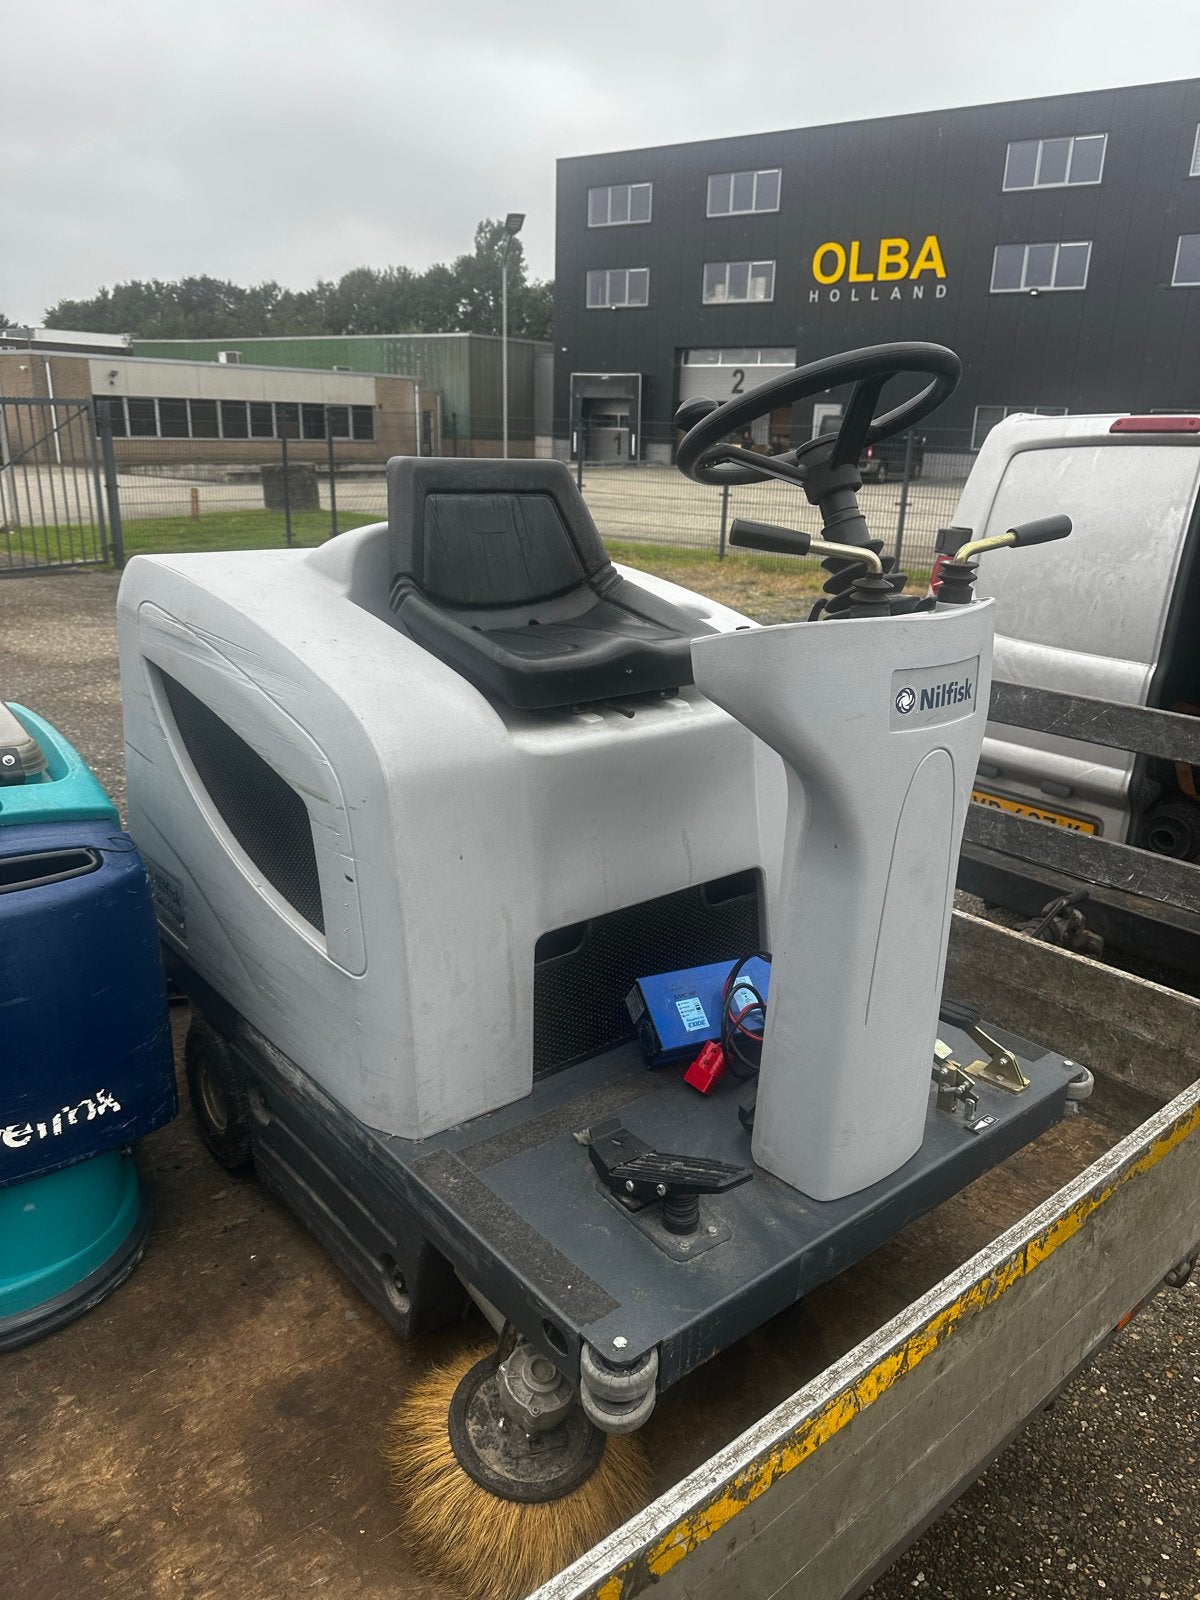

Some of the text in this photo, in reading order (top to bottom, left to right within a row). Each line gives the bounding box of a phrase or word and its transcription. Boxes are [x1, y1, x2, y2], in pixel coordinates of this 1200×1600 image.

[812, 234, 947, 285] OLBA
[809, 285, 947, 303] HOLLAND
[731, 369, 745, 394] 2
[614, 432, 622, 456] 1
[920, 678, 972, 711] Nilfisk
[688, 1020, 706, 1028] EXIDE
